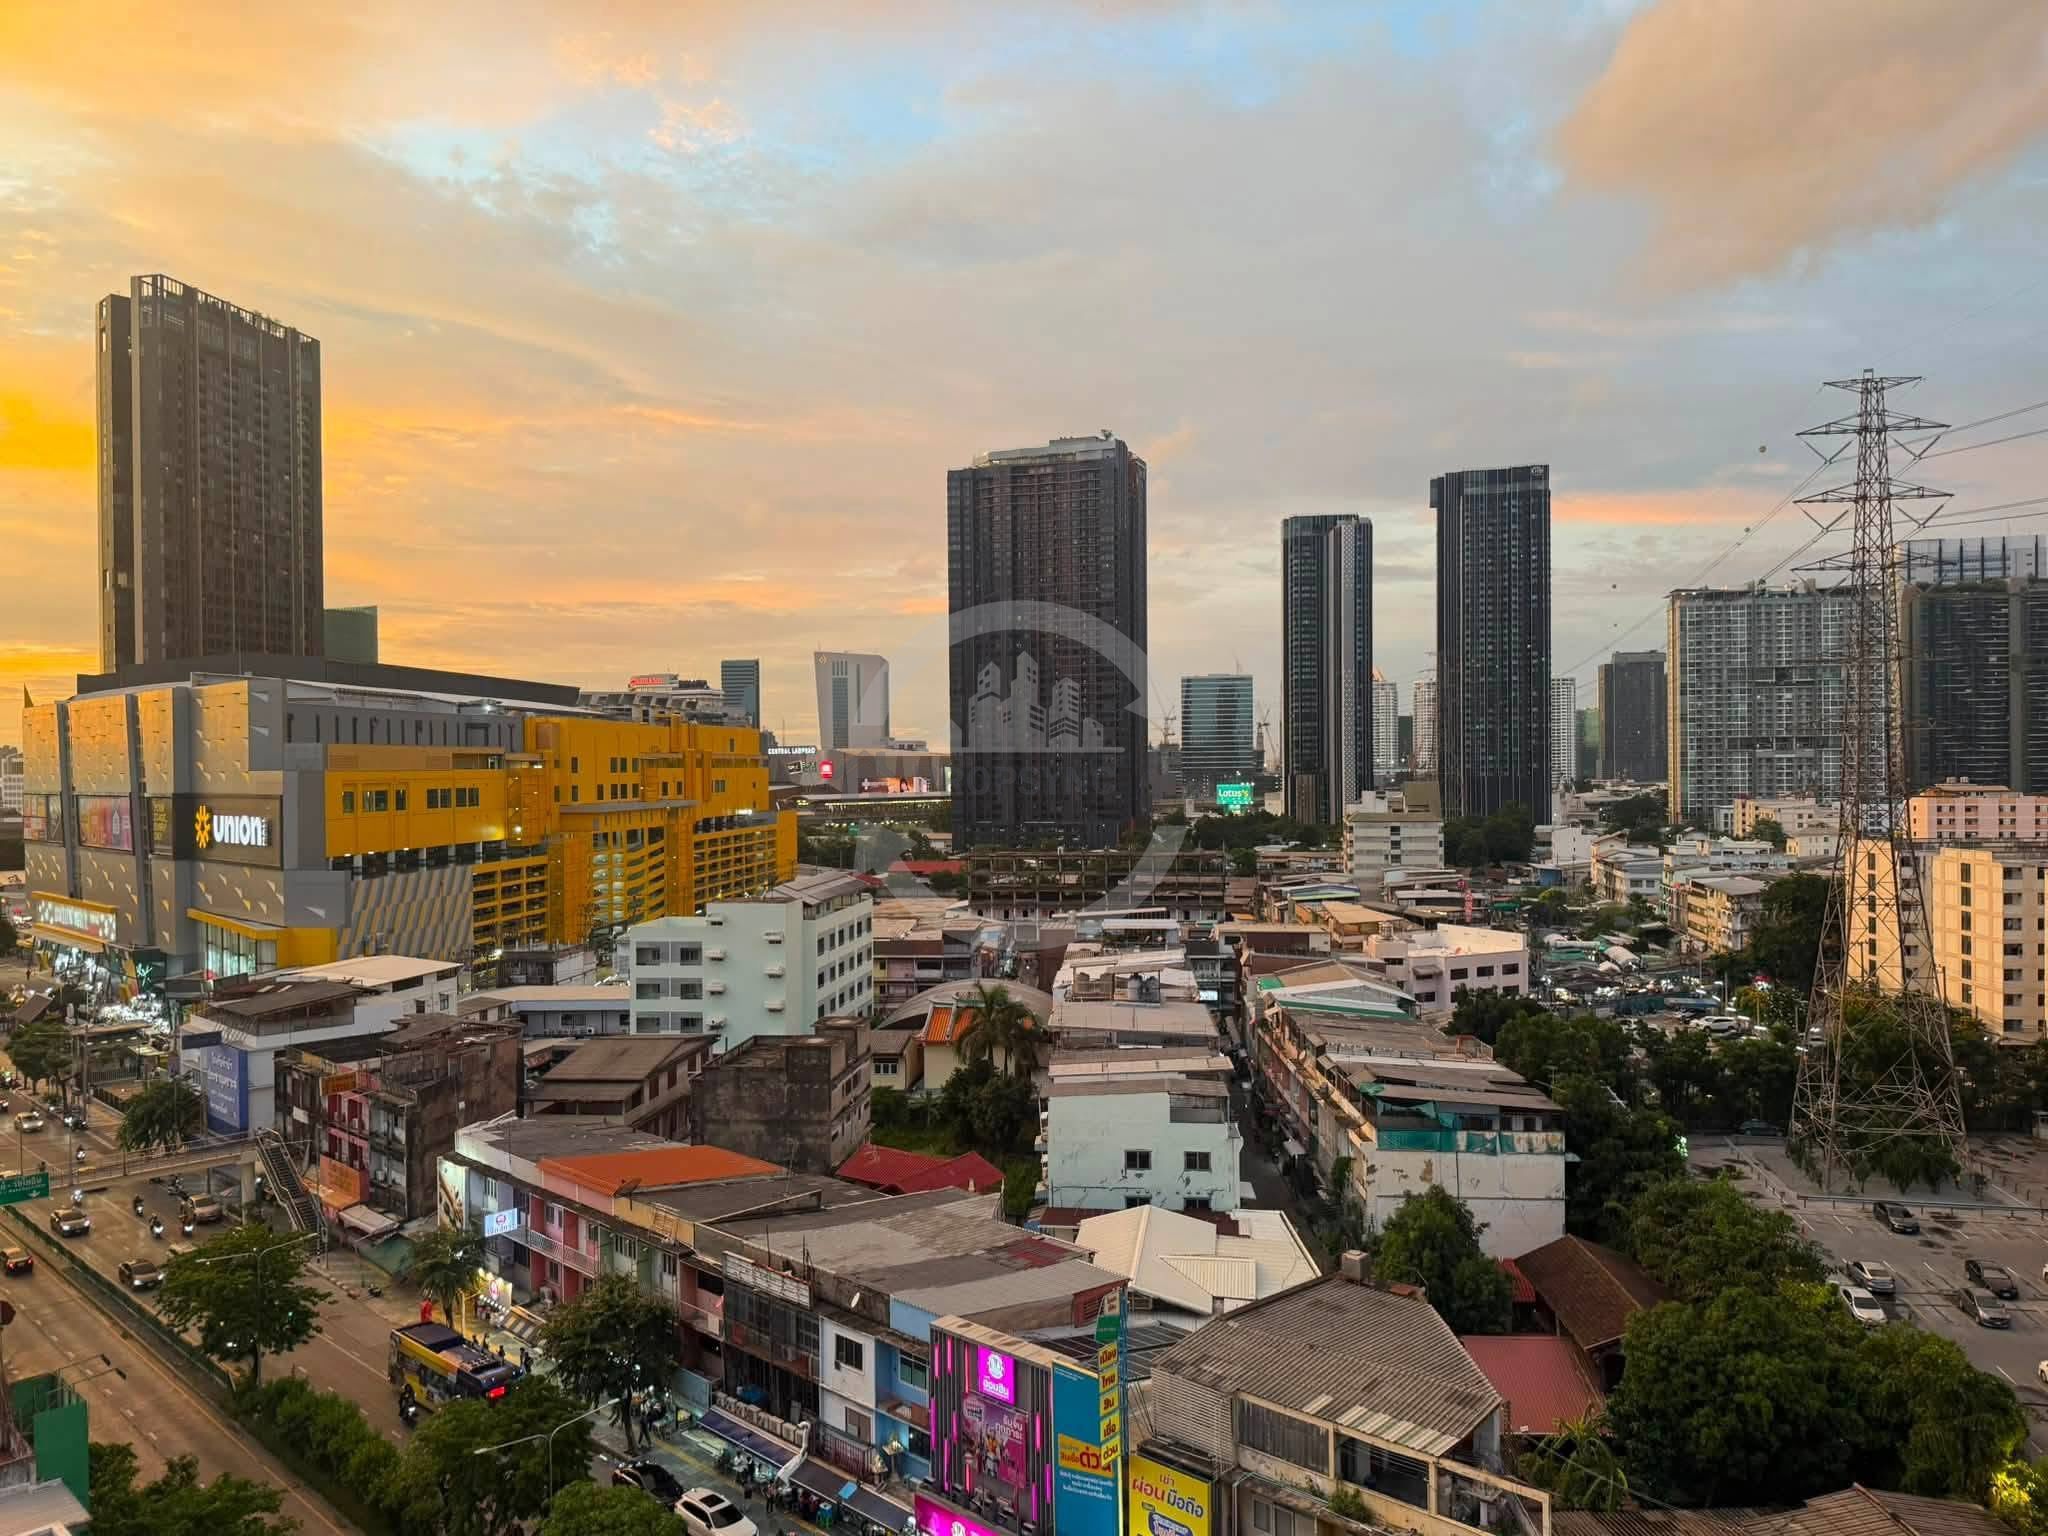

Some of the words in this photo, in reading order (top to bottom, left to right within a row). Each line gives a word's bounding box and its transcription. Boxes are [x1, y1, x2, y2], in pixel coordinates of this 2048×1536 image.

[1132, 1475, 1165, 1502] ผ่อน
[1167, 1488, 1204, 1518] มือถือ
